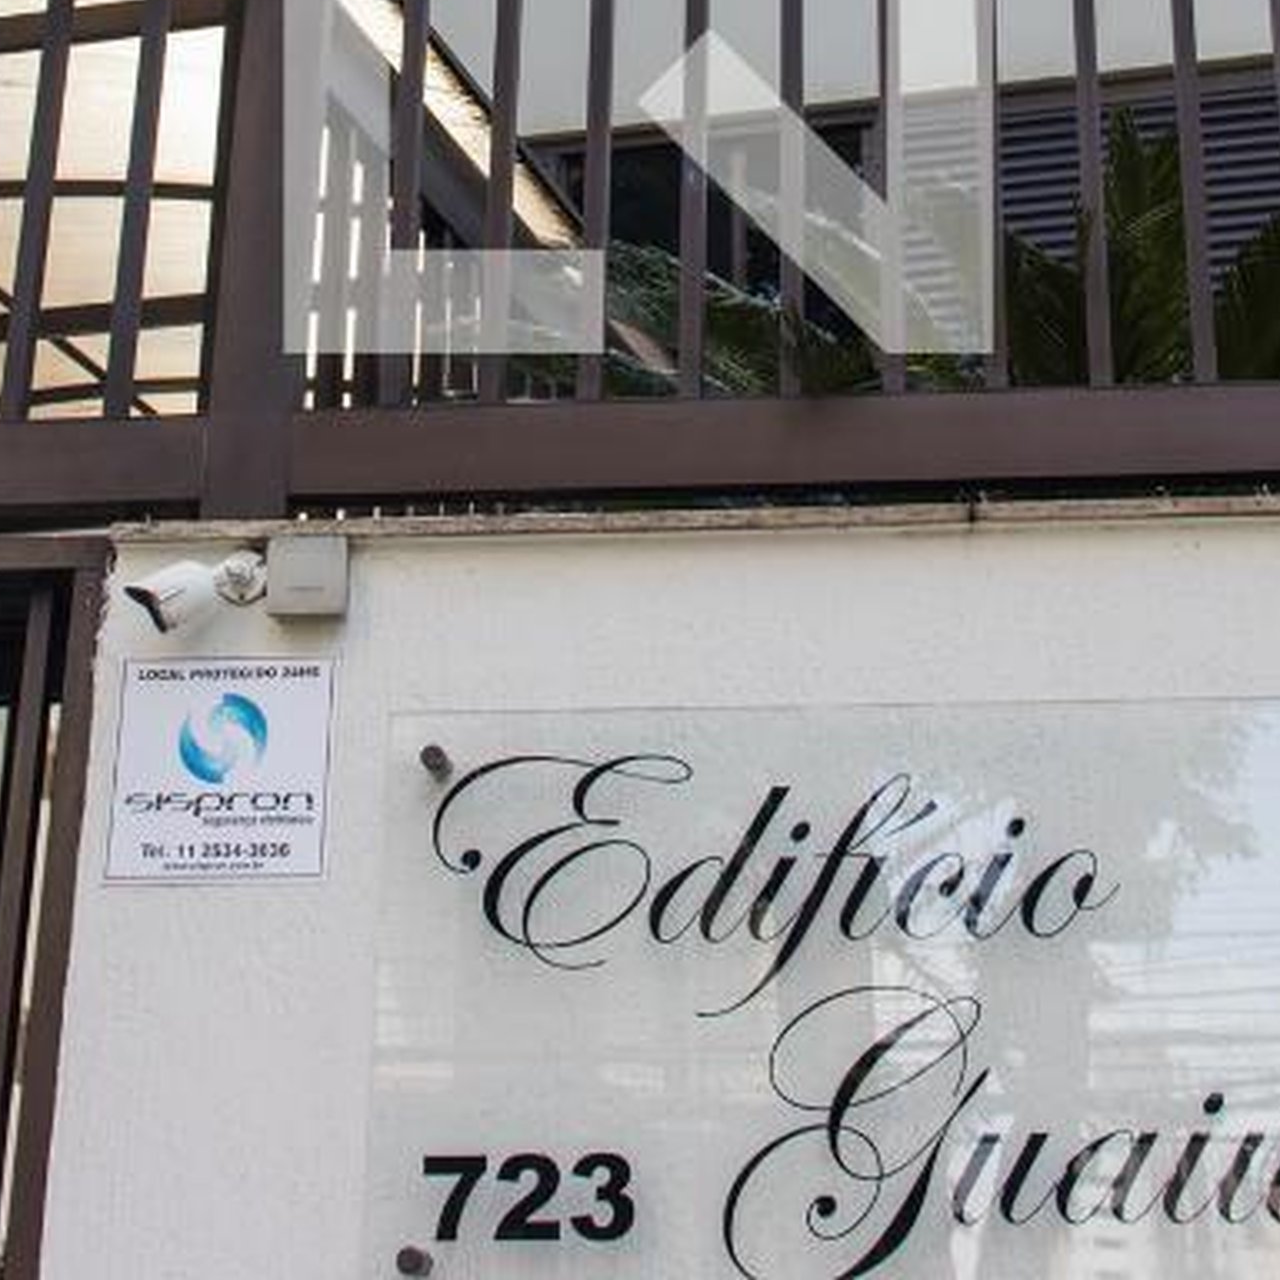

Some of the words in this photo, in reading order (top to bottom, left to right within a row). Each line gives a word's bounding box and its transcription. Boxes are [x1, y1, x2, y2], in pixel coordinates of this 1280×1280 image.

[178, 845, 195, 858] 11
[431, 754, 1121, 1018] Edifício
[423, 1154, 635, 1242] 723
